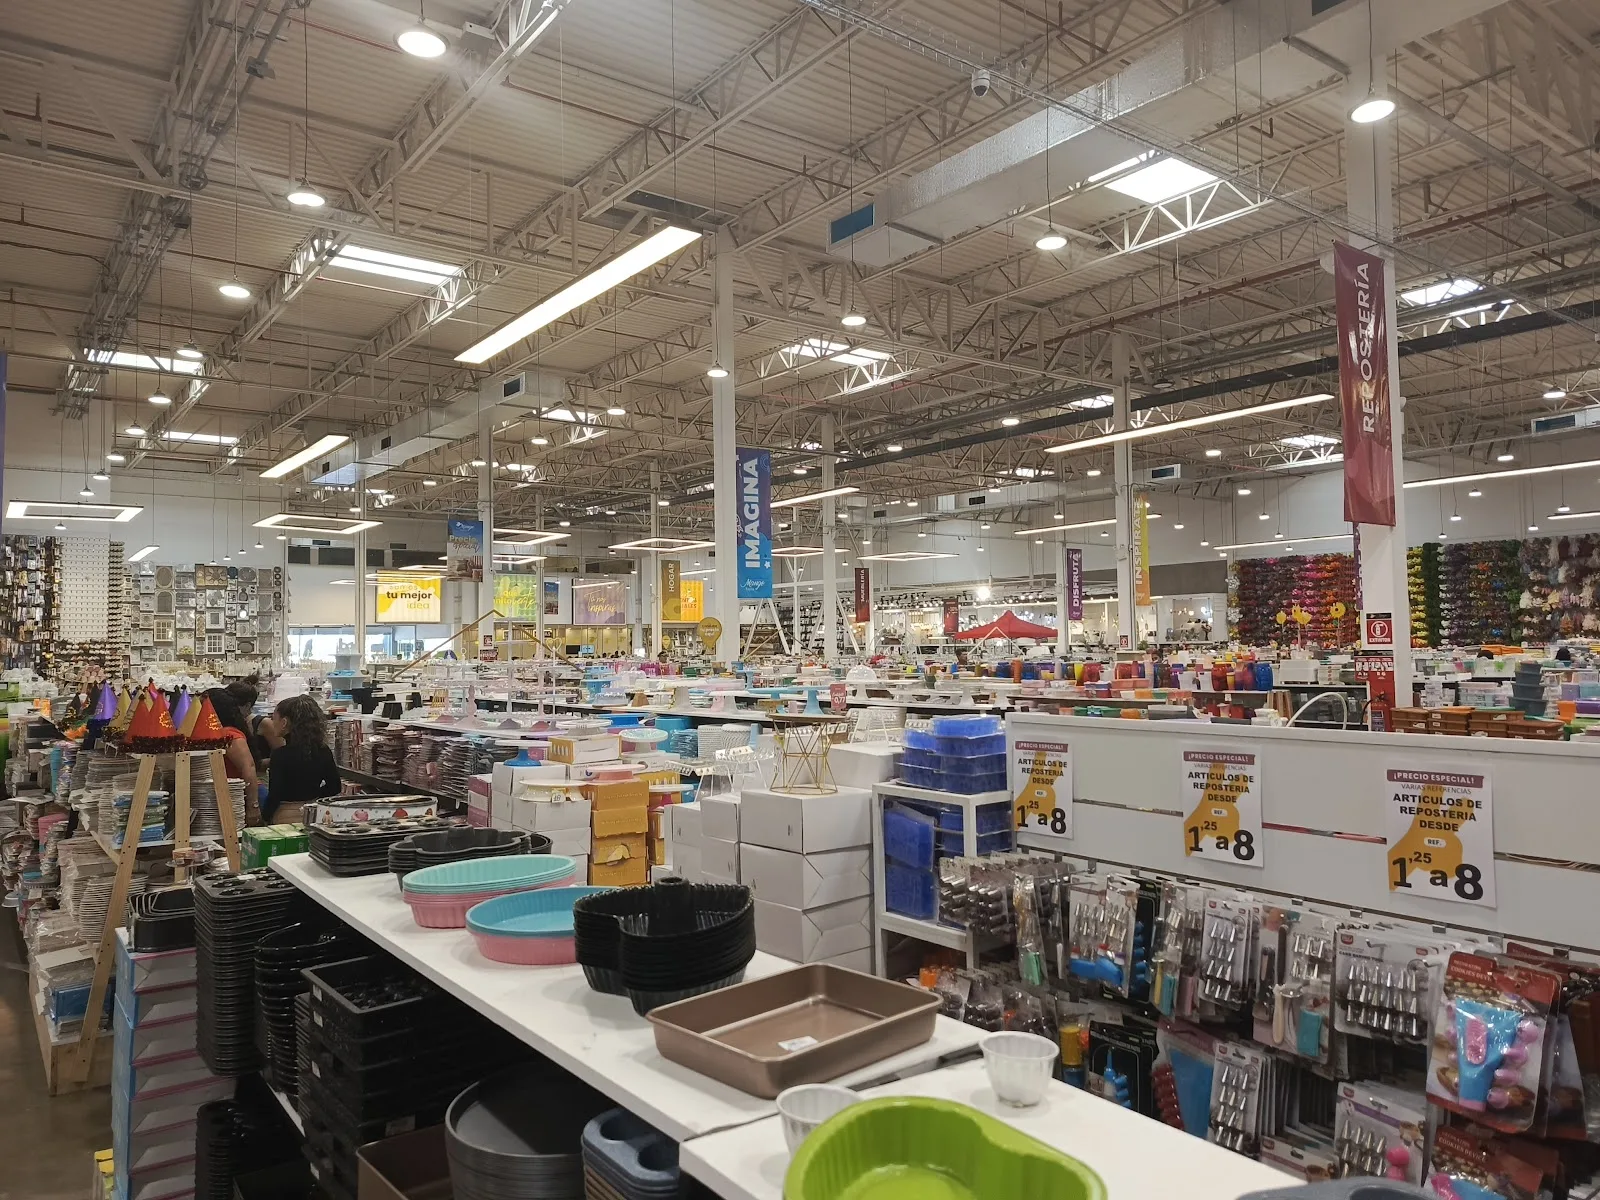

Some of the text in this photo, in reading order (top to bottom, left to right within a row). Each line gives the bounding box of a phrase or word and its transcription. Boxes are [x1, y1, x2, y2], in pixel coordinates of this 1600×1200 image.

[1353, 262, 1375, 433] REPOSTERÍA
[743, 457, 761, 568] IMAGINA
[1072, 552, 1081, 607] DISFRUTA
[386, 591, 432, 602] tu mejor
[406, 601, 430, 609] idea
[1018, 758, 1057, 767] ARTICULOS
[1214, 754, 1249, 762] ESPECIAL!
[1021, 767, 1064, 777] REPOSTERIA
[1187, 771, 1254, 783] ARTICULOS DE
[1393, 771, 1475, 784] ¡PRECIO ESPECIAL!
[1032, 777, 1054, 785] DESDE
[1193, 782, 1250, 794] REPOSTERIA
[1401, 783, 1472, 795] VARIAS REFERENCIAS
[1207, 793, 1237, 803] DESDE
[1392, 793, 1482, 809] ARTICULOS DE
[1399, 805, 1477, 822] REPOSTERIA
[1037, 812, 1048, 826] a
[1050, 807, 1067, 834] 8
[1419, 819, 1459, 832] DESDE
[1215, 834, 1229, 851] a
[1233, 829, 1255, 861] 8
[1429, 869, 1448, 888] a
[1454, 863, 1484, 901] 8
[1450, 965, 1476, 977] COOKIES
[1438, 1136, 1486, 1163] COOKIES DEVICE
